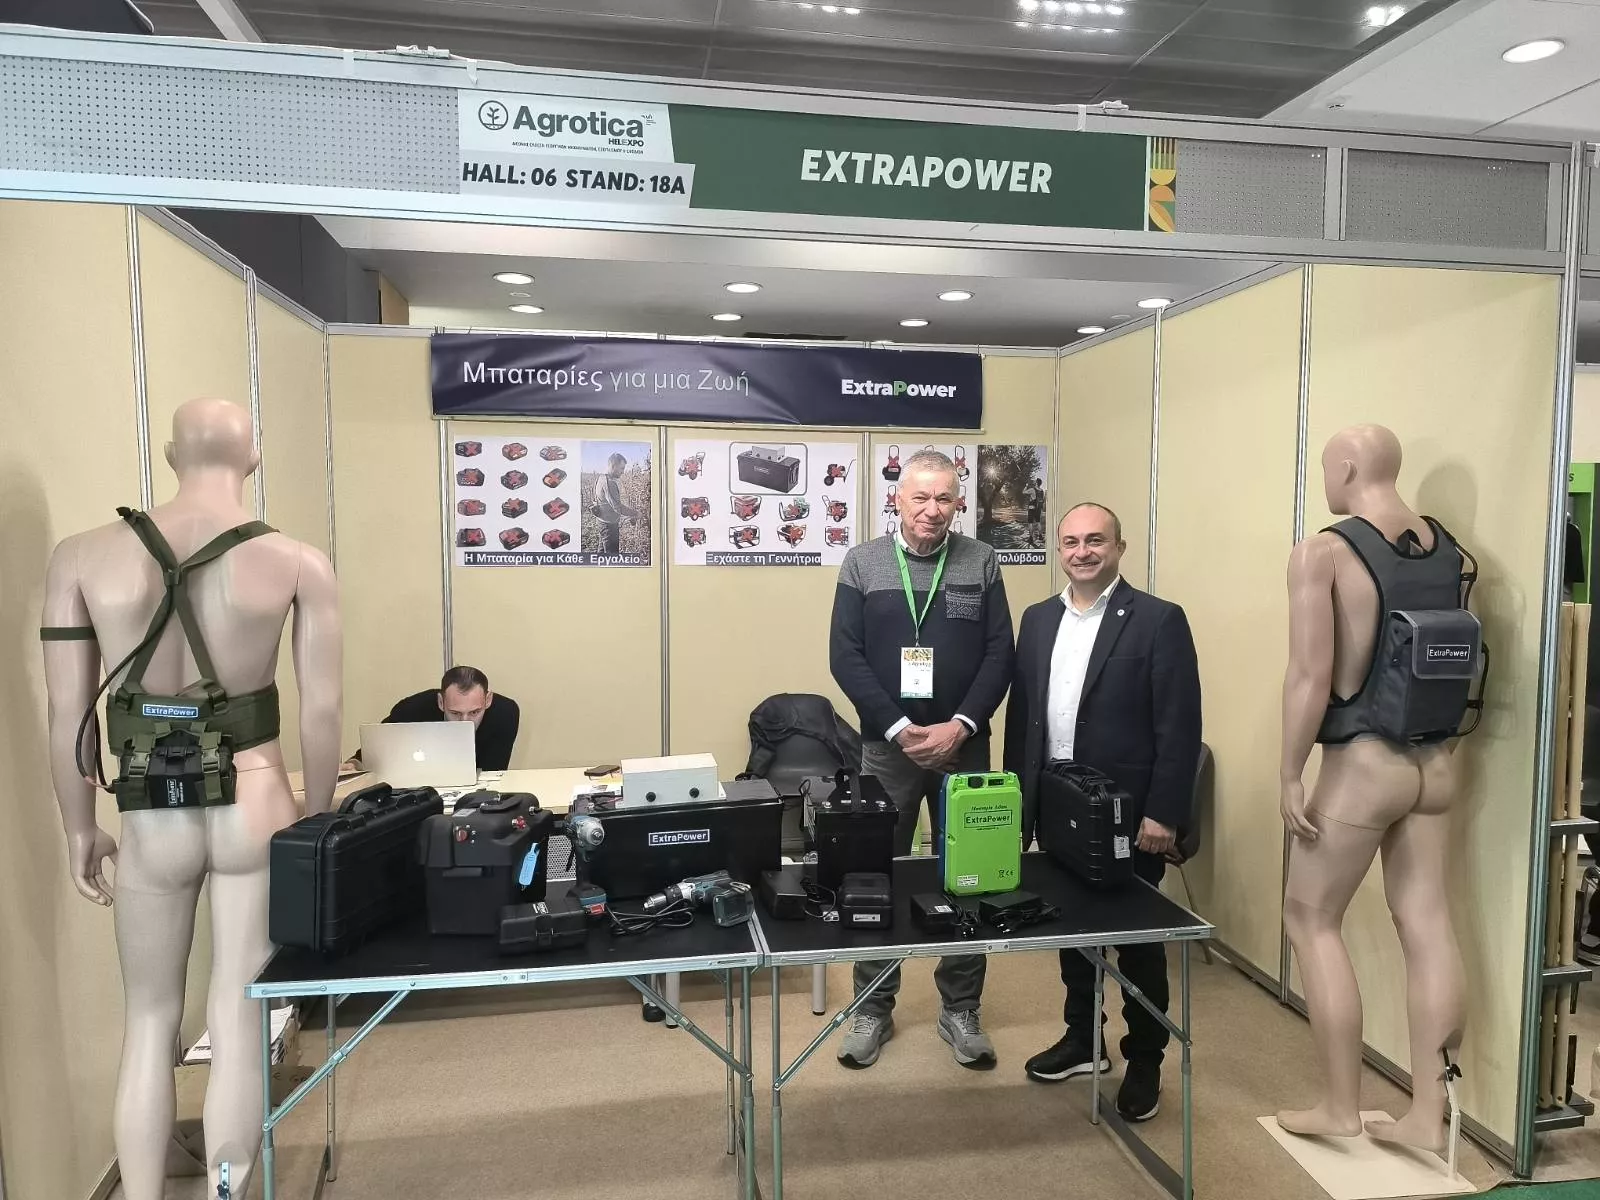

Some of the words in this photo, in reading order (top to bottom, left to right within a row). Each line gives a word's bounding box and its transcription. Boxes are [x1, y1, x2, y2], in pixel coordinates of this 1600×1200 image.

[512, 105, 644, 138] Agrotica
[608, 138, 645, 148] HELEXPO
[800, 148, 1052, 194] EXTRAPOWER
[462, 162, 525, 185] HALL:
[530, 168, 557, 186] 06
[565, 169, 644, 192] STAND:
[649, 175, 686, 194] 18A
[463, 361, 603, 392] Μπαταρίες
[609, 371, 646, 393] για
[654, 372, 691, 394] μια
[697, 369, 750, 396] Ζωή
[841, 378, 957, 398] ExtraPower
[465, 553, 474, 563] Η
[476, 553, 534, 565] Μπαταρία
[536, 554, 554, 566] για
[556, 554, 584, 564] Κάθε
[590, 554, 640, 566] Εργαλείο
[706, 553, 751, 565] Ξεχάστε
[753, 554, 766, 565] τη
[768, 553, 821, 566] Γεννήτρια
[1428, 648, 1469, 658] ExtraPower
[145, 706, 196, 716] ExtraPower
[965, 815, 1010, 825] ExtraPower
[652, 833, 707, 843] ExtraPower
